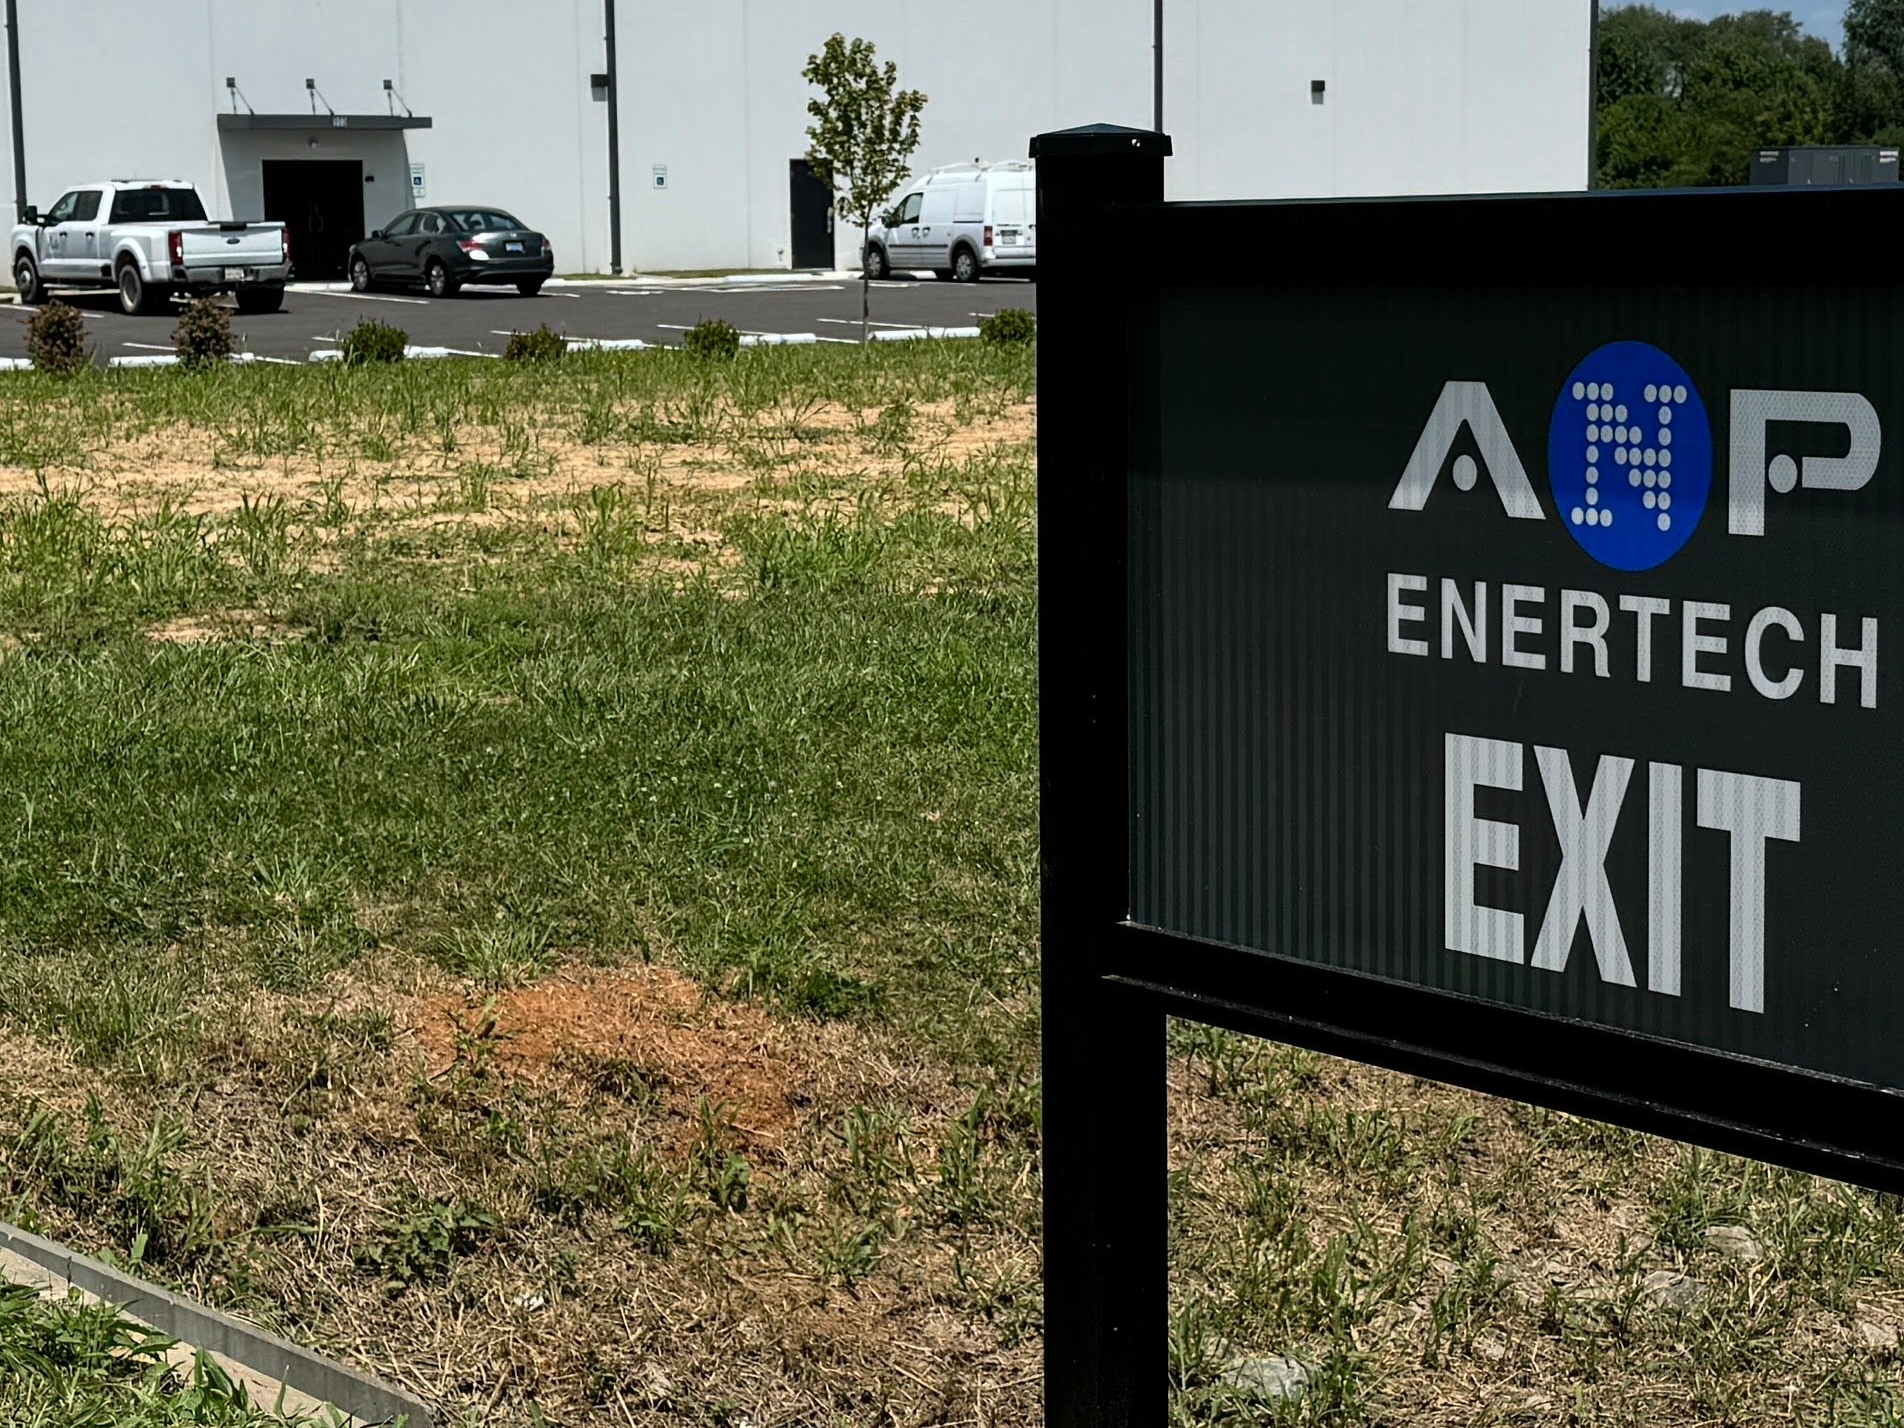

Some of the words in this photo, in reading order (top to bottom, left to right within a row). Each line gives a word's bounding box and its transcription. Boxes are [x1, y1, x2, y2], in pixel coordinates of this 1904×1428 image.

[1386, 379, 1883, 537] ANP
[1386, 571, 1879, 710] ENERTECH
[1443, 731, 1802, 1015] EXIT
